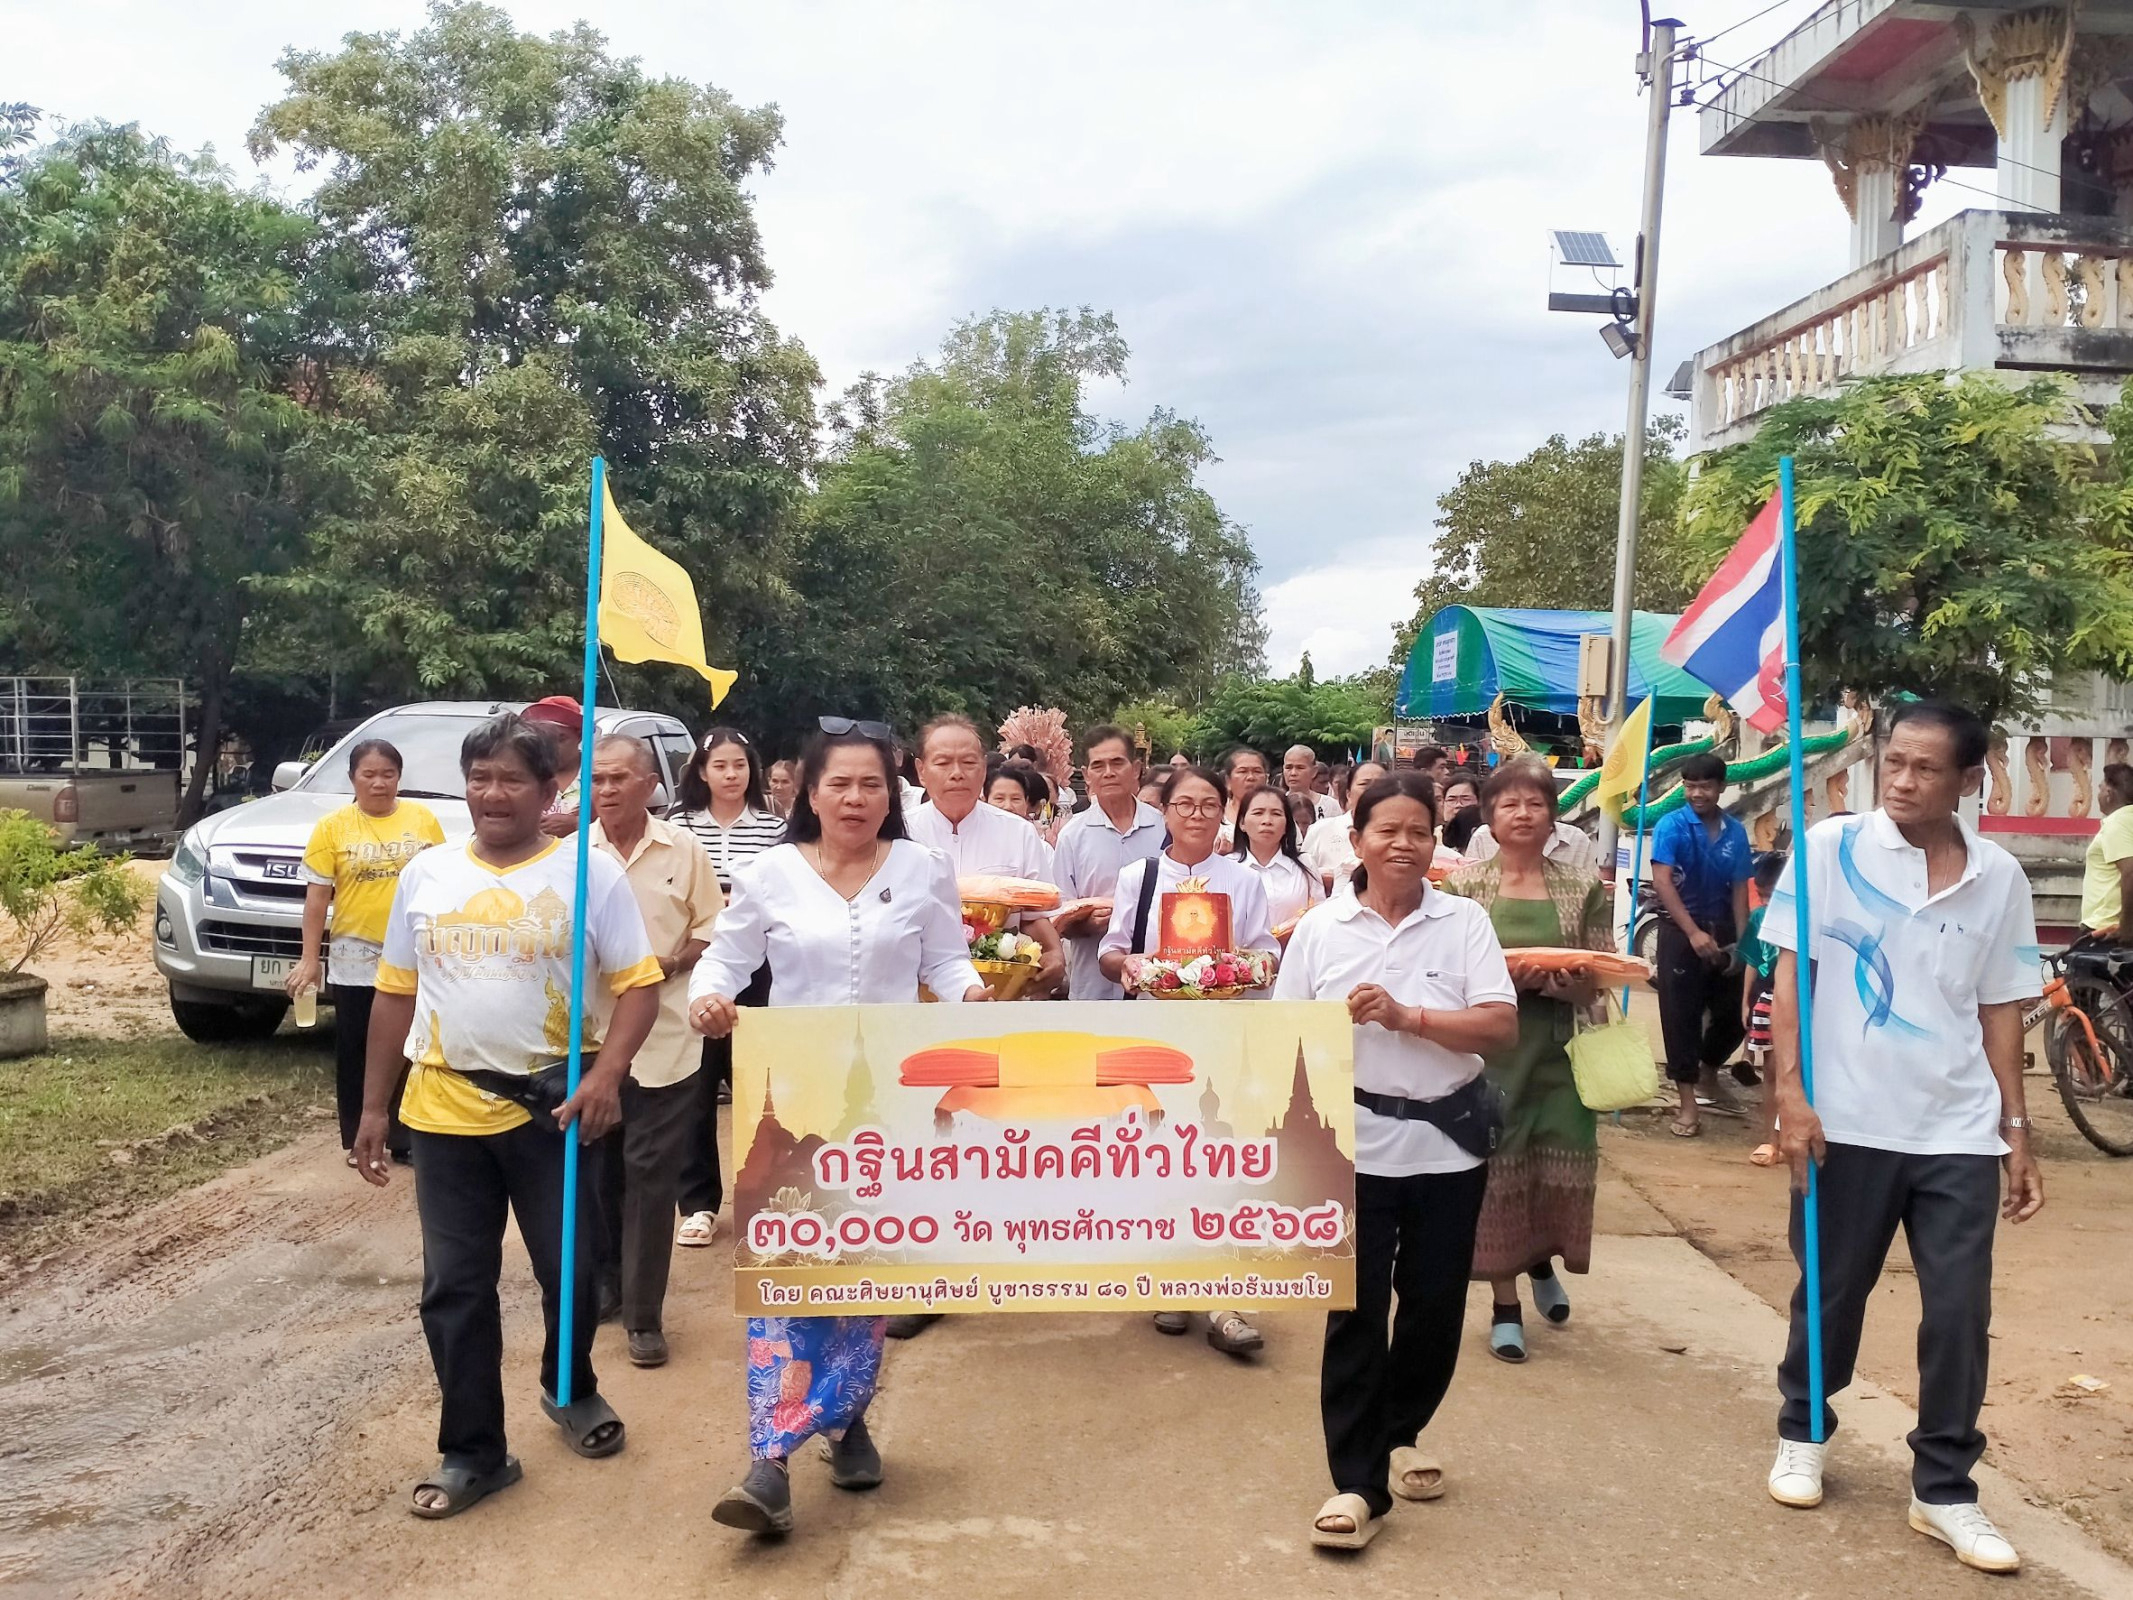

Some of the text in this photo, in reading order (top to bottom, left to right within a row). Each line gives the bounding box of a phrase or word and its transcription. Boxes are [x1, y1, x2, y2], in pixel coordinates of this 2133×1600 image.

[265, 862, 300, 878] ISU
[819, 1111, 1271, 1198] กฐินสามัคคีทั่วไทย
[754, 1205, 1338, 1254] ๓๐,๐๐๐ วัด พุทธศักราช ๒๕๖๘
[760, 1275, 1331, 1305] โดย คณะศิษยานุศิษย์ บูชาธรรม ๘๑ ปี หลวงพ่อธัมมชโย
